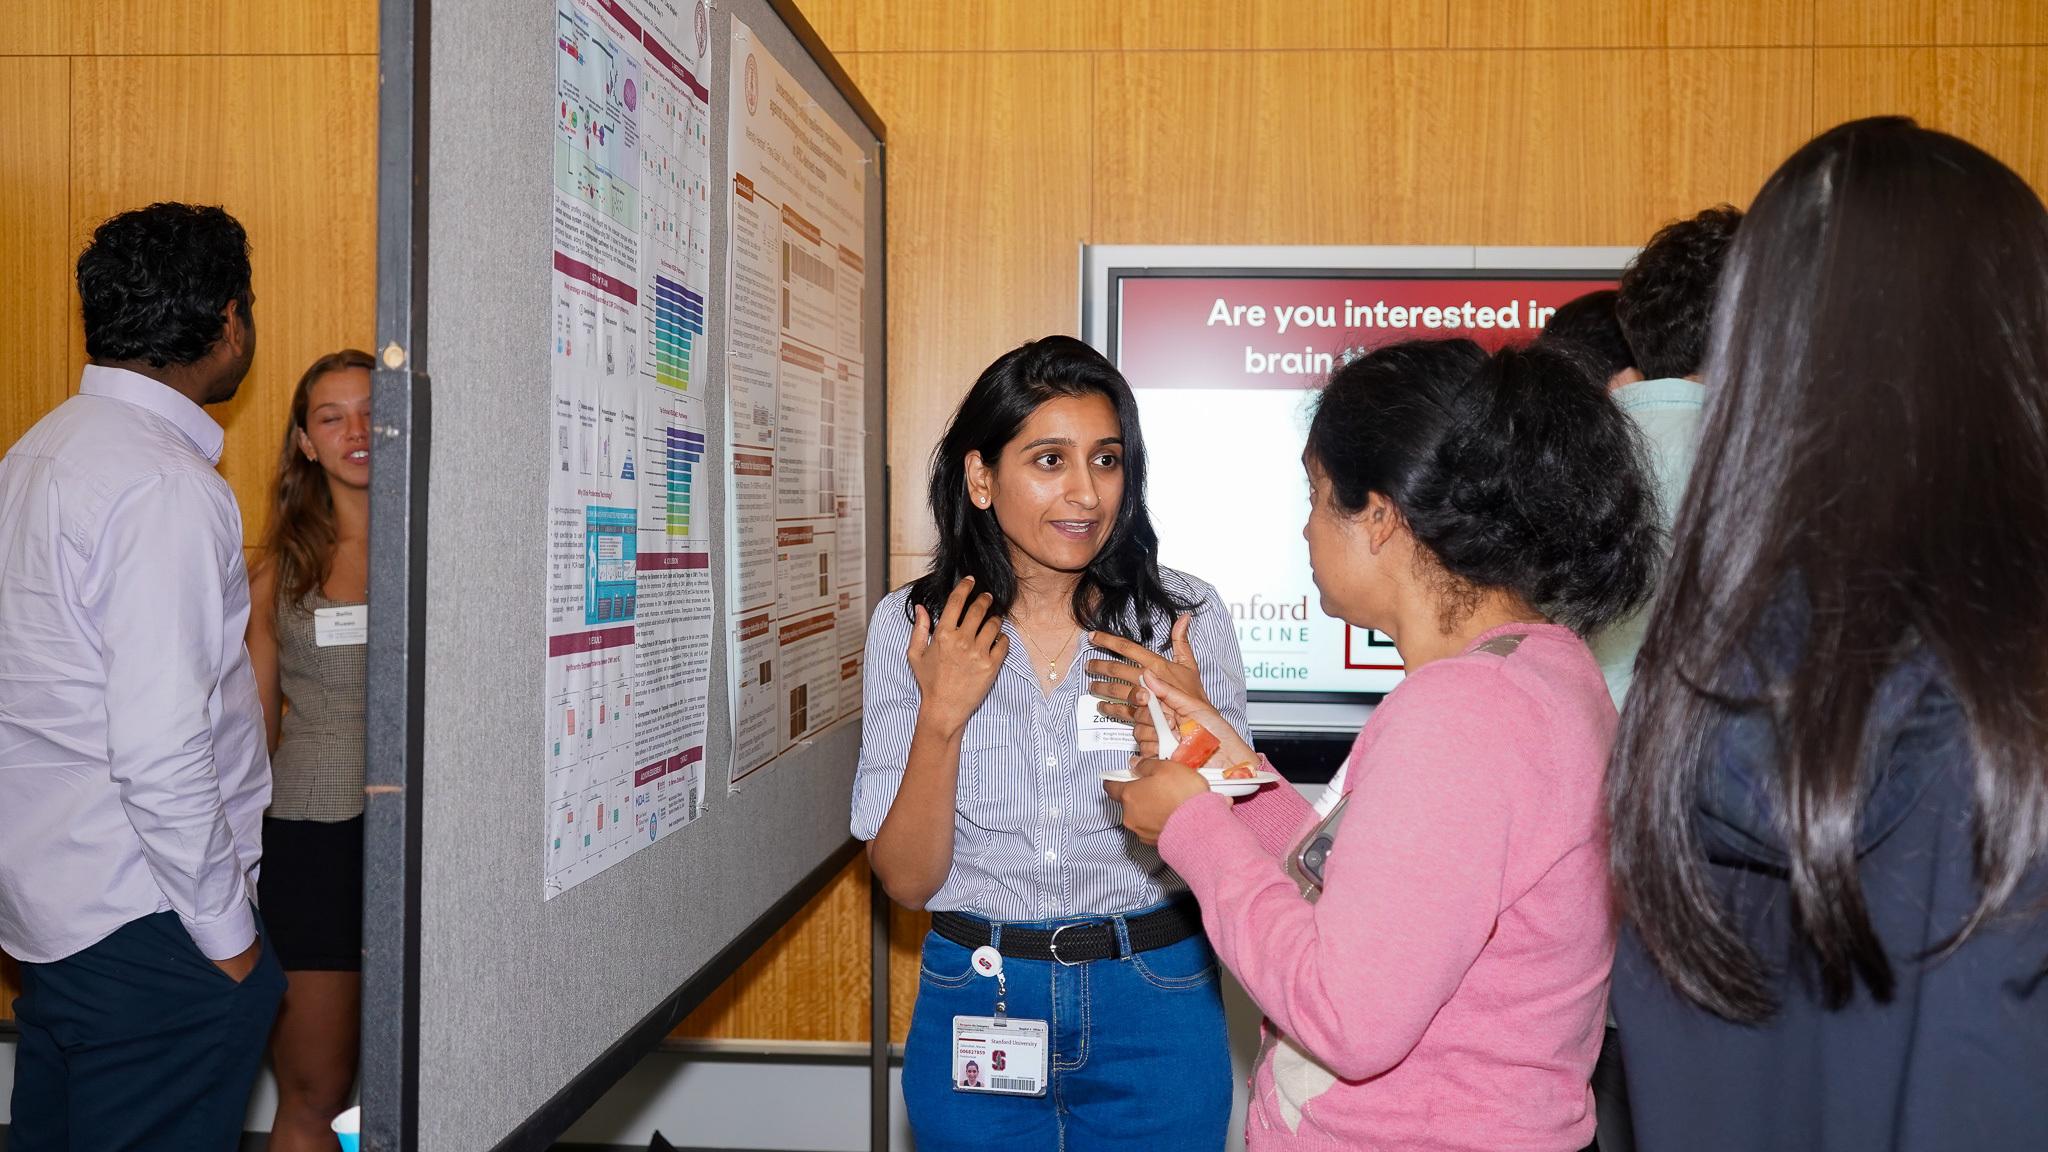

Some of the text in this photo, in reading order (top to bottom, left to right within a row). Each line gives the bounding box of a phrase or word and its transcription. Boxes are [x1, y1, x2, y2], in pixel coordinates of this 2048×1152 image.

[1207, 299, 1266, 327] Are
[1273, 305, 1337, 334] you
[1344, 299, 1521, 329] interested
[1245, 346, 1333, 374] brain
[1230, 594, 1308, 621] nford
[1239, 627, 1310, 642] ICINE
[1245, 662, 1309, 680] edicine
[1012, 1040, 1037, 1048] University
